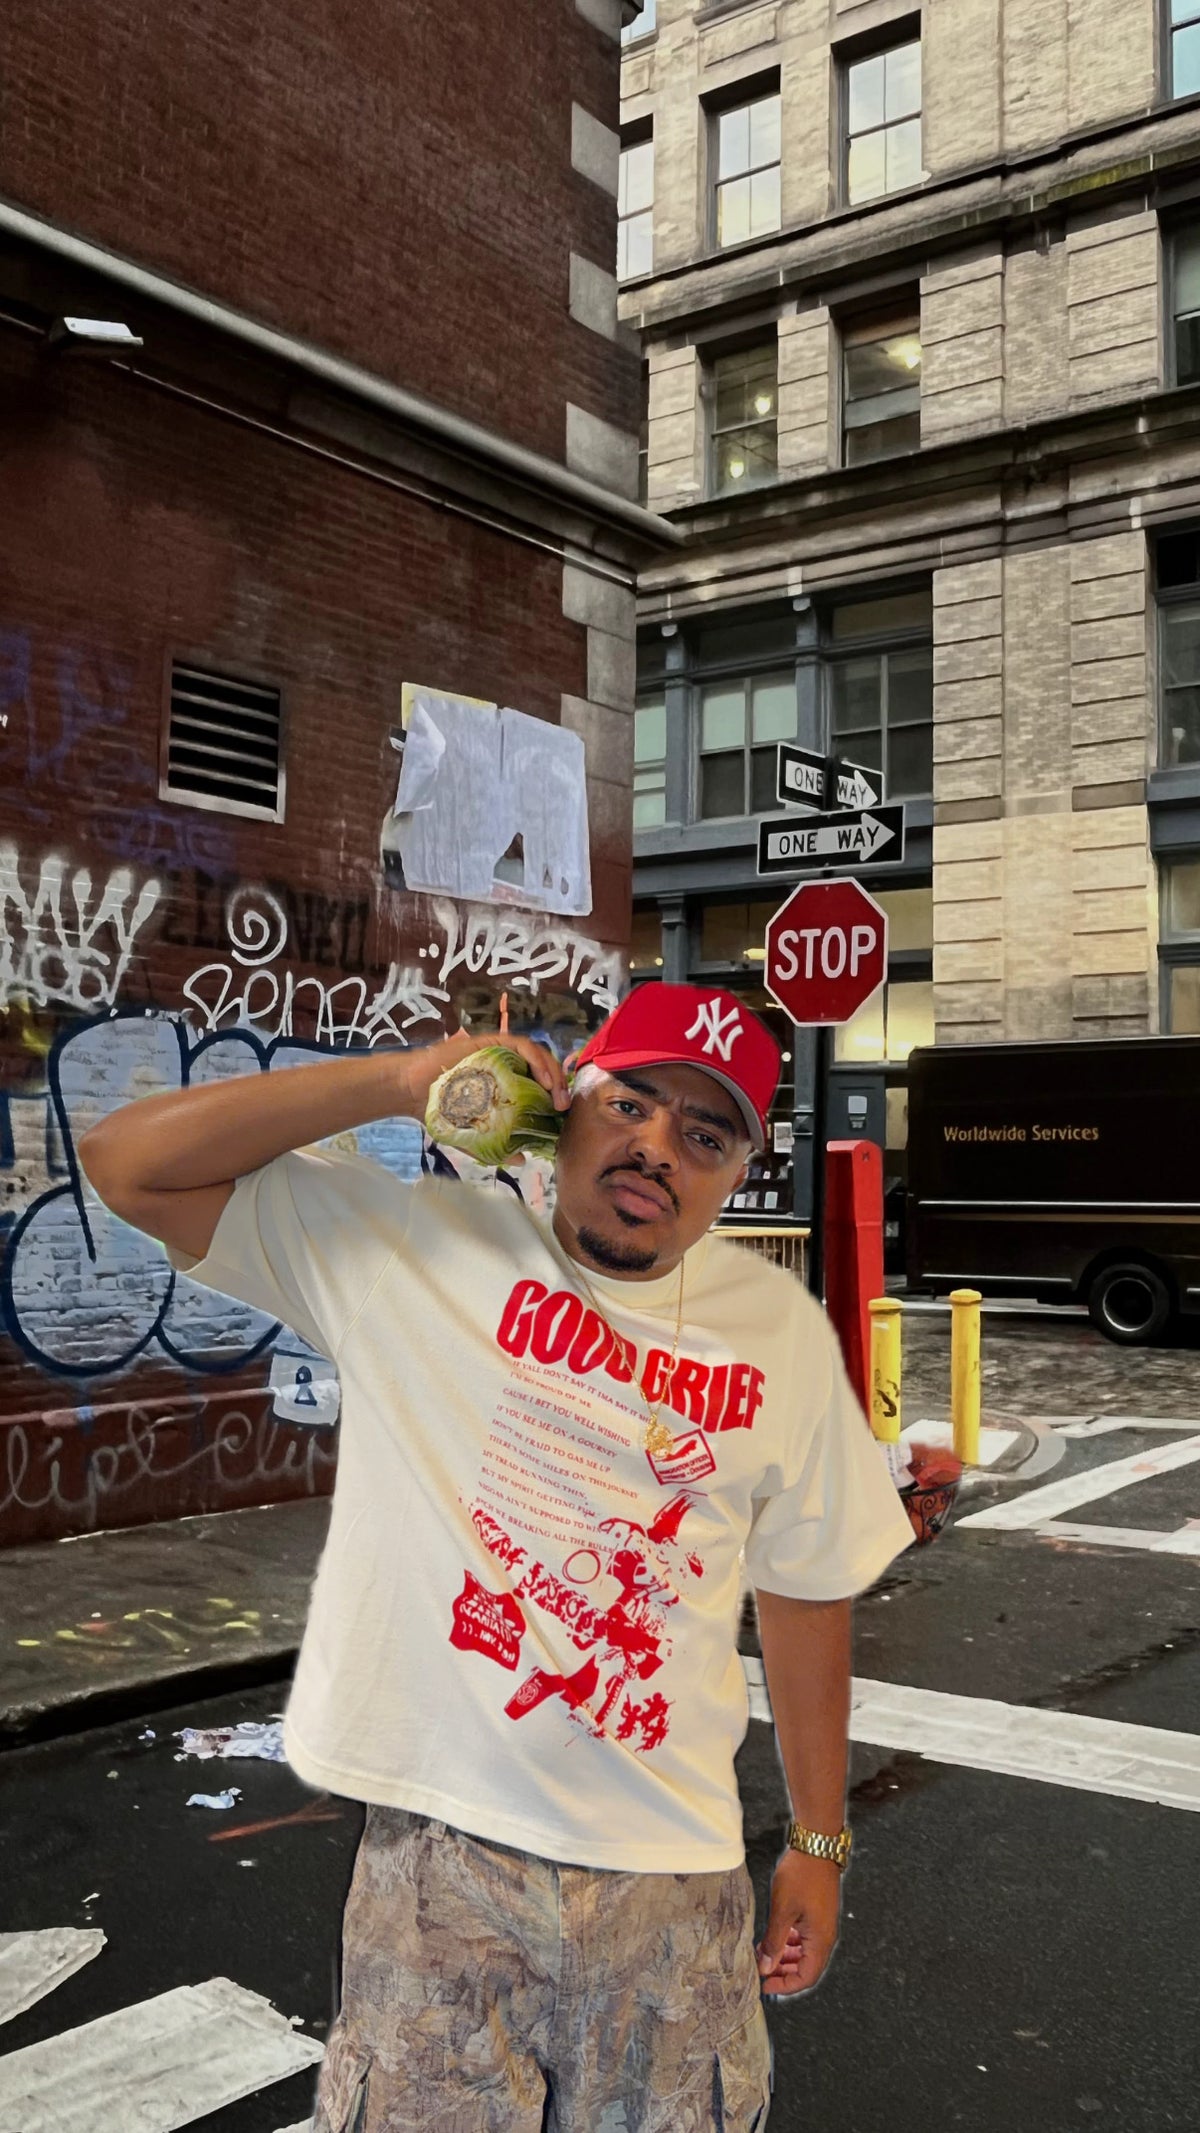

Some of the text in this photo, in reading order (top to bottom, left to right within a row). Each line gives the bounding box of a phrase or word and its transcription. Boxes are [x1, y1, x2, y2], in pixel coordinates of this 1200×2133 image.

[794, 767, 868, 800] ONE WAY
[779, 825, 880, 855] ONE WAY
[774, 925, 877, 981] STOP
[684, 997, 744, 1062] NY
[944, 1124, 1099, 1142] Worldwide Services
[496, 1279, 638, 1384] GOOD
[640, 1348, 766, 1434] GRIEF
[535, 1381, 563, 1396] PROUD
[564, 1391, 577, 1401] OF
[579, 1398, 592, 1408] ME
[543, 1368, 570, 1382] DON'T
[570, 1378, 586, 1389] SAY
[587, 1385, 597, 1394] IT
[615, 1401, 630, 1412] SAY
[630, 1409, 639, 1417] IT
[502, 1387, 529, 1401] CAUSE
[535, 1398, 552, 1409] BET
[552, 1404, 573, 1418] YOU
[574, 1413, 596, 1431] WELL
[597, 1424, 631, 1448] WISHING
[505, 1407, 522, 1419] YOU
[522, 1413, 537, 1426] SEE
[537, 1420, 553, 1432] ME
[552, 1426, 568, 1437] ON
[494, 1454, 519, 1471] TREAD
[519, 1467, 560, 1489] RUNNING
[524, 1436, 551, 1452] FRAID
[552, 1446, 566, 1457] TO
[567, 1452, 584, 1464] GAS
[586, 1459, 598, 1470] ME
[599, 1464, 611, 1473] UP
[519, 1449, 541, 1465] SOME
[542, 1461, 570, 1477] MILES
[571, 1471, 587, 1481] ON
[588, 1476, 607, 1488] THIS
[607, 1484, 638, 1500] JOURNEY
[528, 1505, 571, 1525] SUPPOSED
[572, 1519, 584, 1529] TO
[536, 1491, 575, 1510] GETTING
[507, 1515, 551, 1538] BREAKING
[552, 1532, 567, 1542] ALL
[569, 1536, 586, 1548] THE
